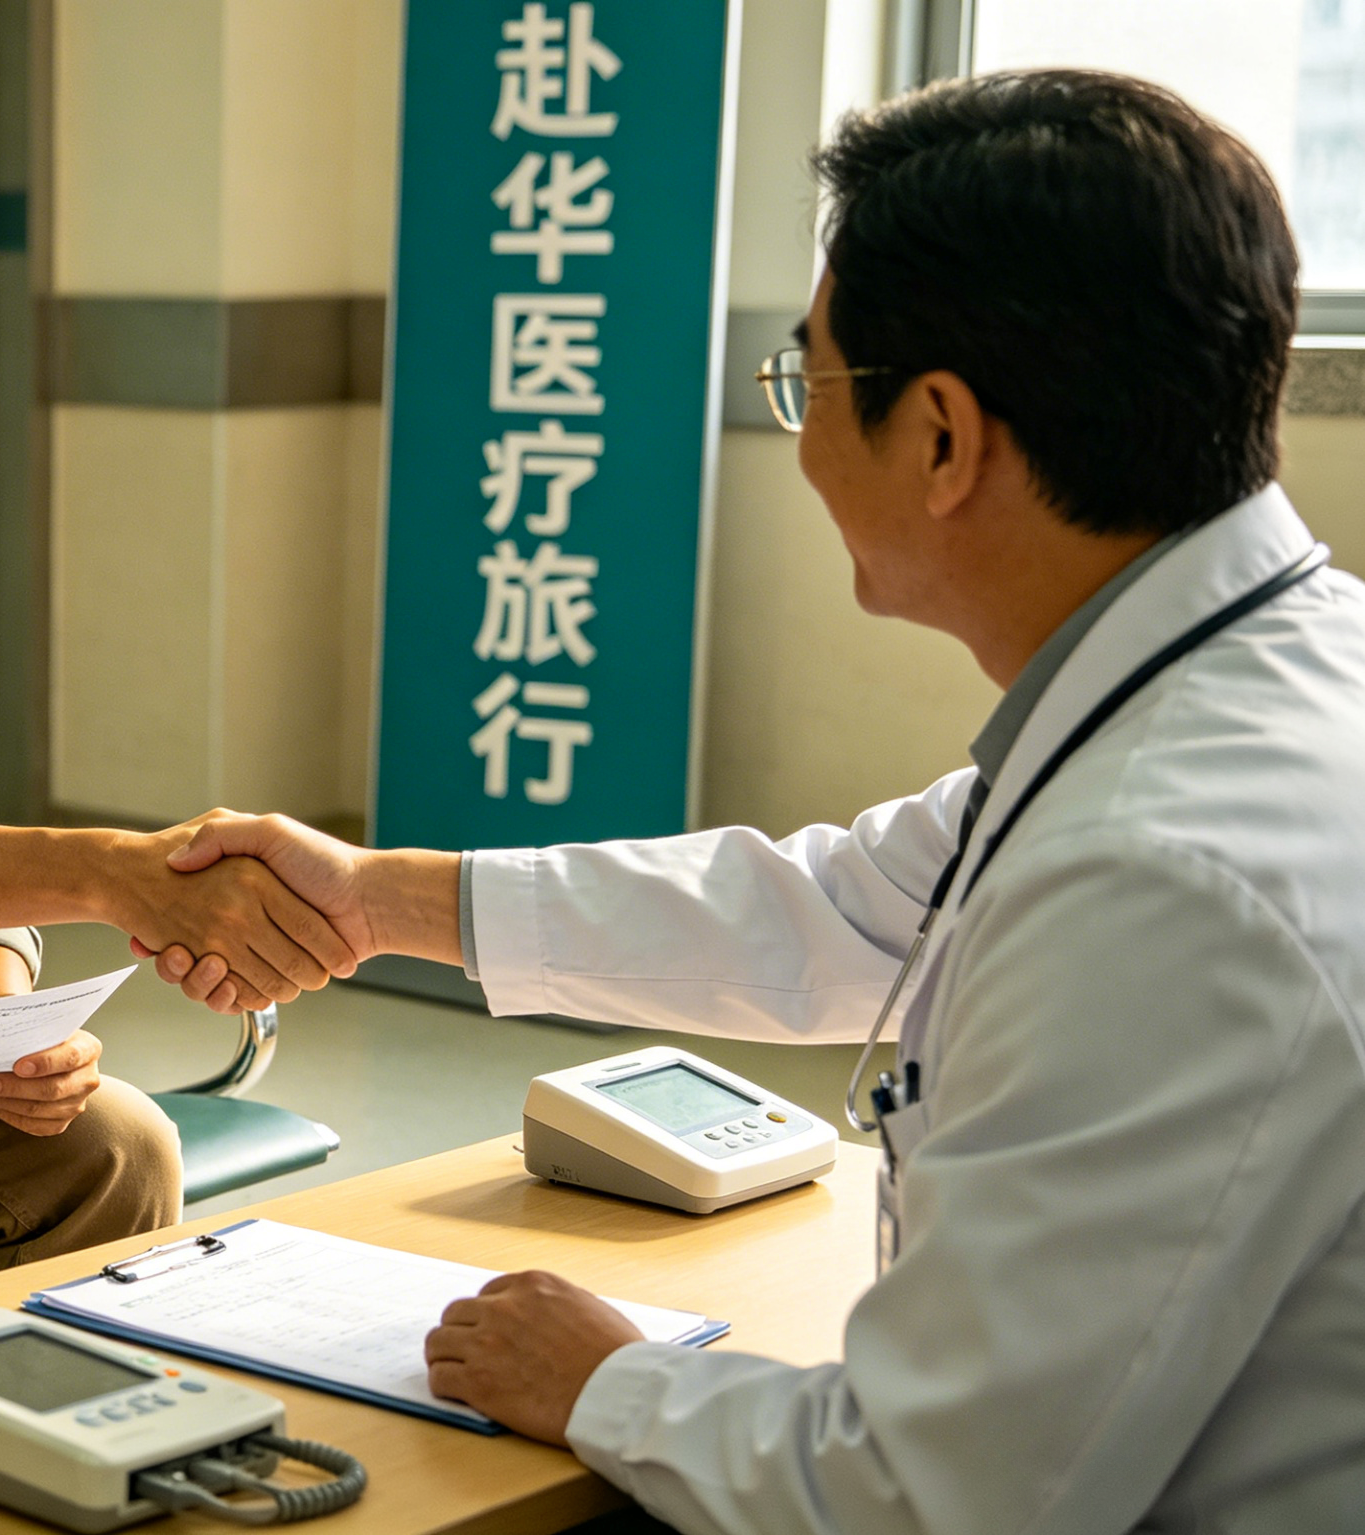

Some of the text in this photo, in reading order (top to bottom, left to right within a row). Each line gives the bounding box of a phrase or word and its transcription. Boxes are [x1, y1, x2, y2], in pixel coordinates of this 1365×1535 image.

[470, 2, 622, 804] 赴华医疗旅行
